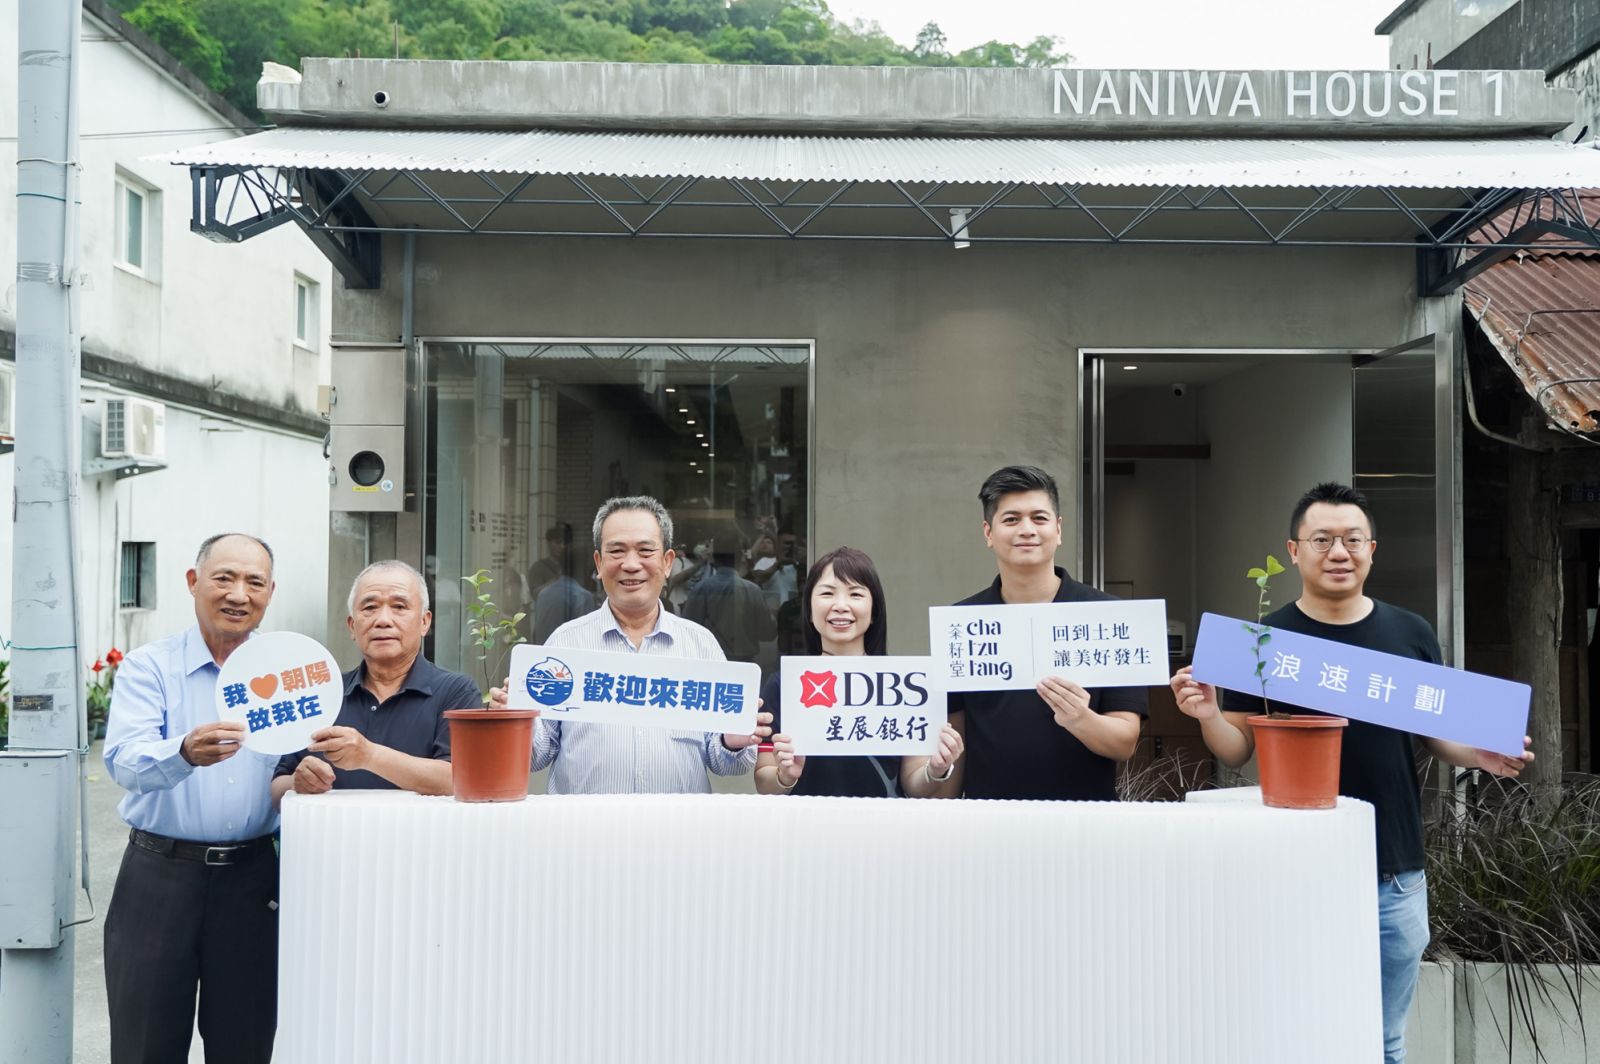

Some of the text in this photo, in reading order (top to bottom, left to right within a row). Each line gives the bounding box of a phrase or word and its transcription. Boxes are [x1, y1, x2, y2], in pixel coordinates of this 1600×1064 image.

[1052, 70, 1503, 117] NANIWA HOUSE 1
[966, 619, 1001, 636] cha
[1052, 622, 1130, 642] 回到土地
[949, 623, 965, 678] 茶籽堂
[968, 639, 998, 656] tzu
[1054, 647, 1151, 667] 讓美好發生
[222, 660, 331, 708] 我 朝陽
[969, 659, 1013, 680] tang
[1271, 651, 1446, 715] 浪速計劃
[583, 671, 744, 714] 歡迎來朝陽
[843, 671, 929, 707] DBS
[246, 695, 323, 733] 故我在
[826, 715, 929, 742] 星展銀行
